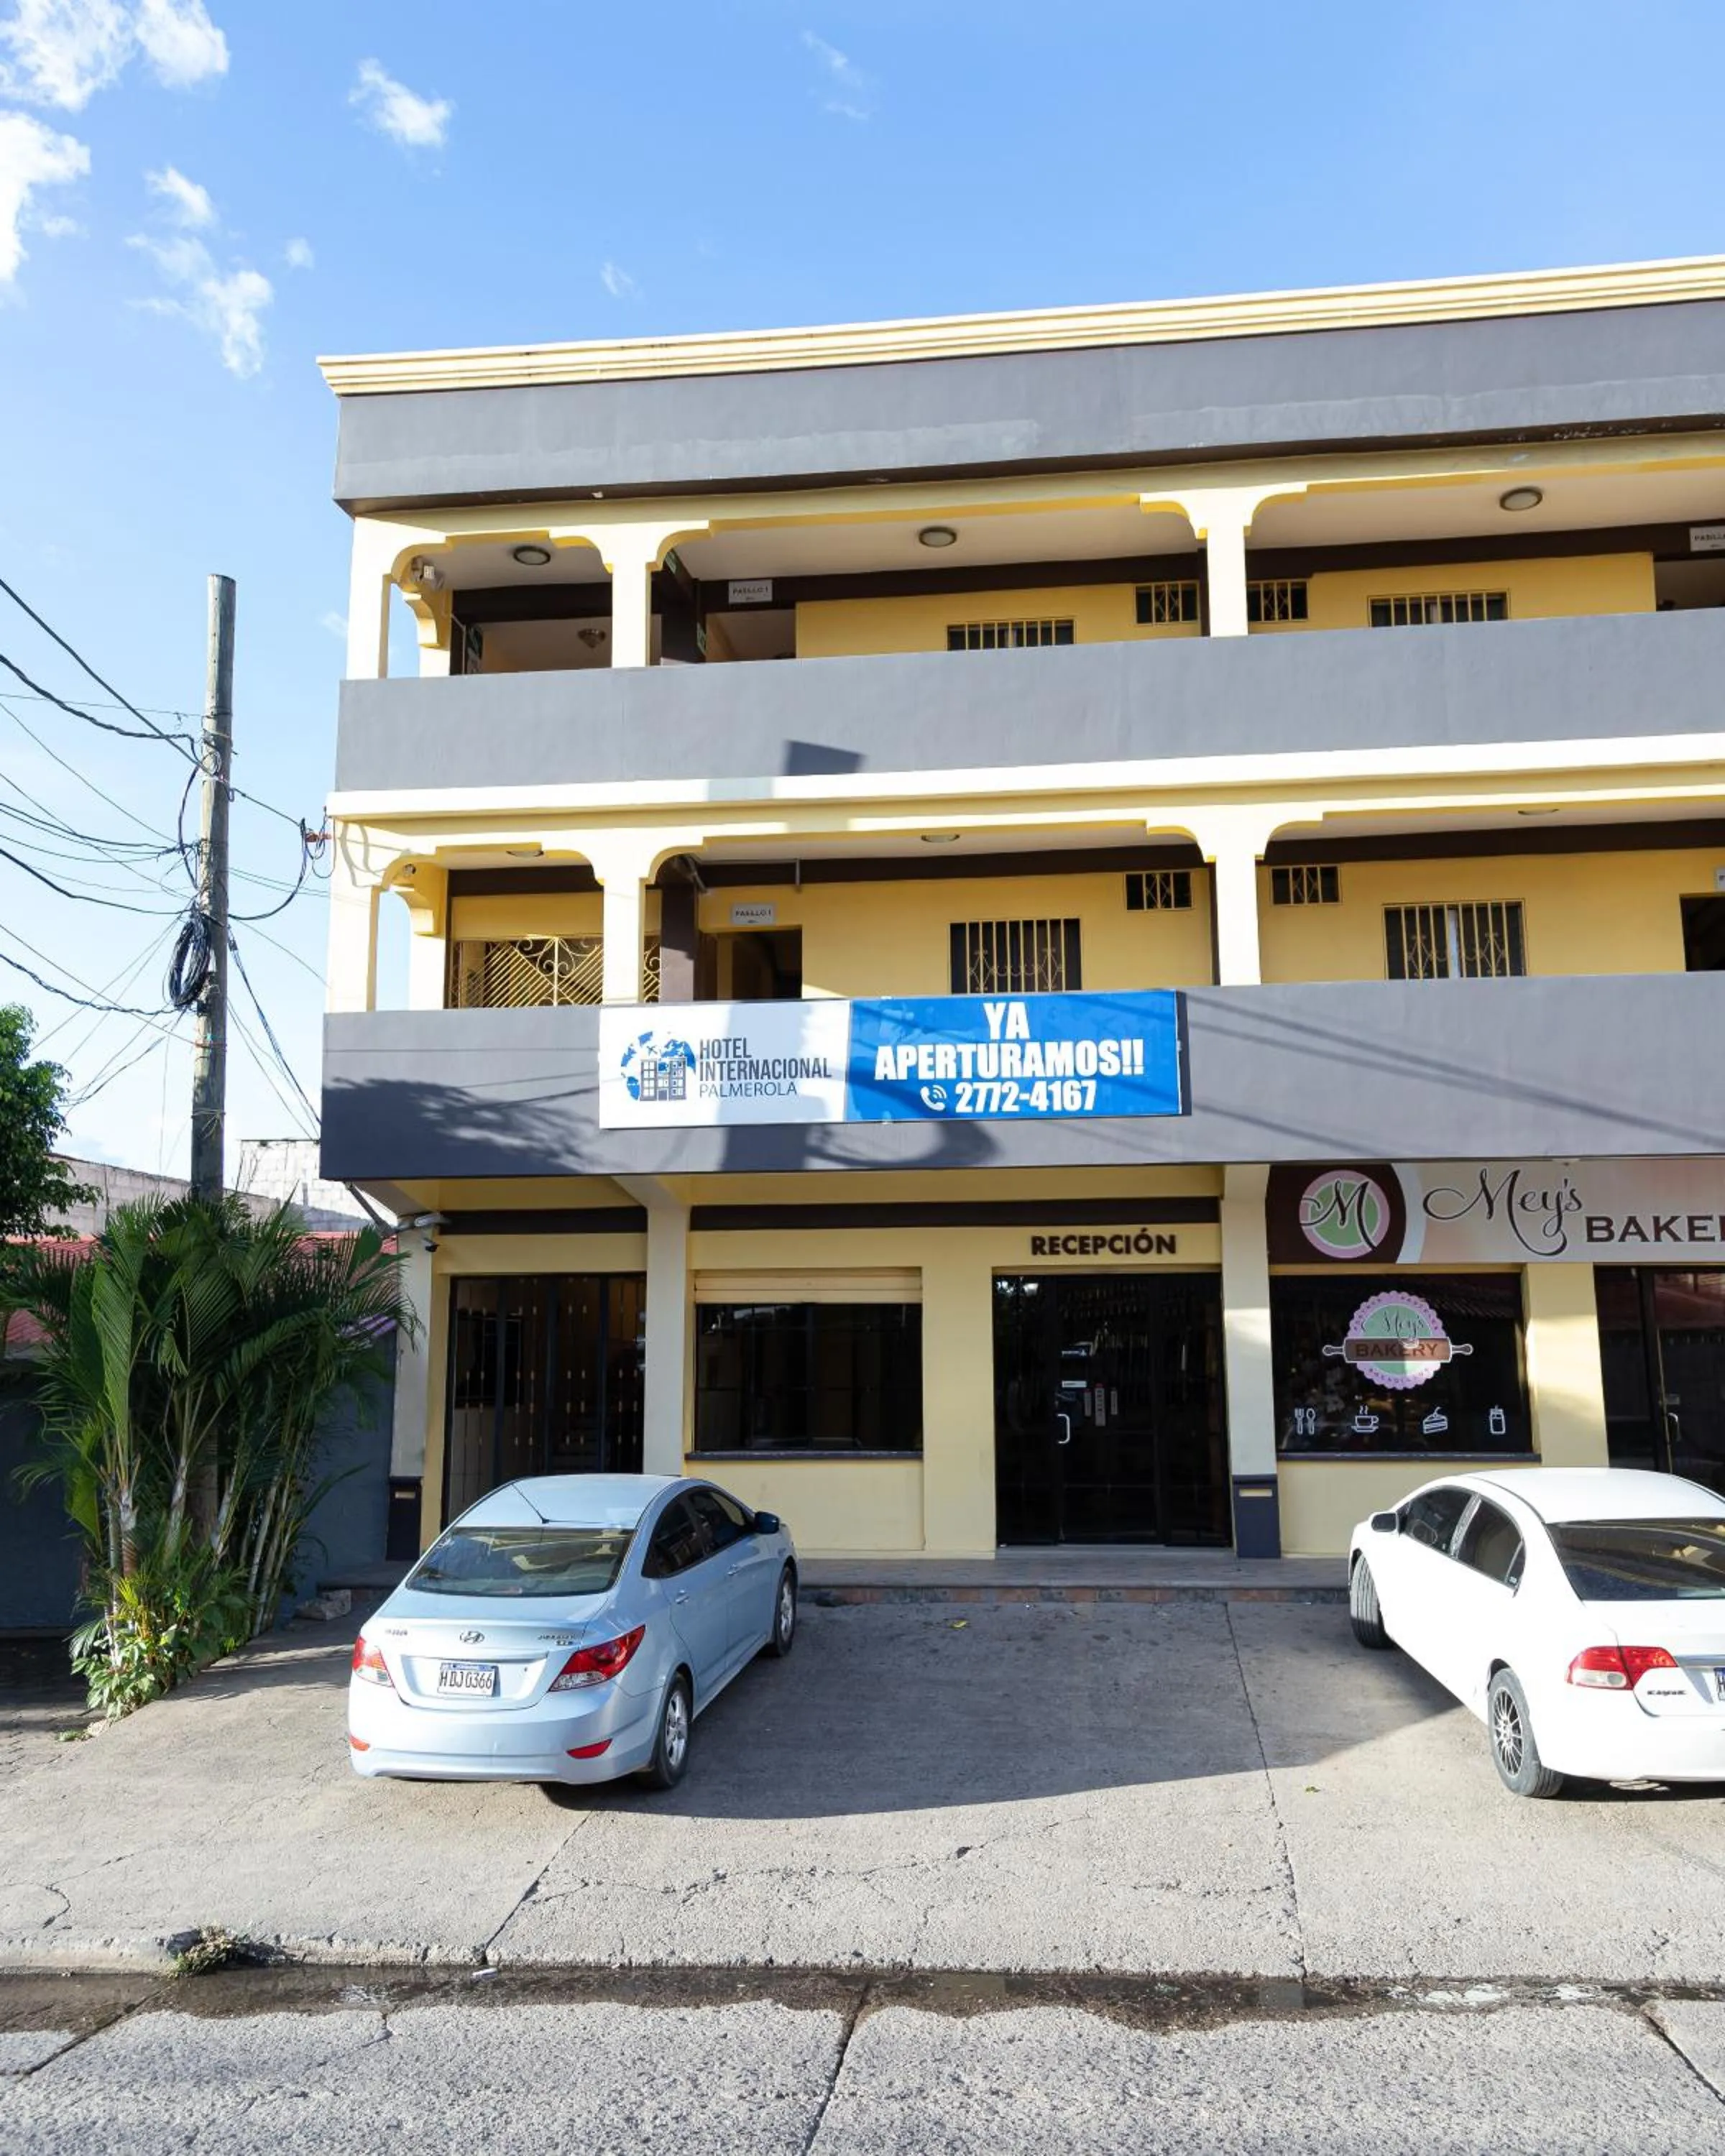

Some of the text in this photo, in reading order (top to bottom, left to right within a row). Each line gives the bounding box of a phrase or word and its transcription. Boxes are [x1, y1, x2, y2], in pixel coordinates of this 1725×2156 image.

[983, 1001, 1030, 1040] YA
[699, 1037, 752, 1059] HOTEL
[874, 1039, 1144, 1080] APERTURAMOS!!
[699, 1057, 832, 1081] INTERNACIONAL
[699, 1081, 797, 1098] PALMEROLA
[955, 1080, 1097, 1113] 2772-4167
[1422, 1168, 1725, 1256] Mey's BAKE
[1031, 1227, 1176, 1256] RECEPCIÓN
[1356, 1343, 1438, 1358] BAKERY
